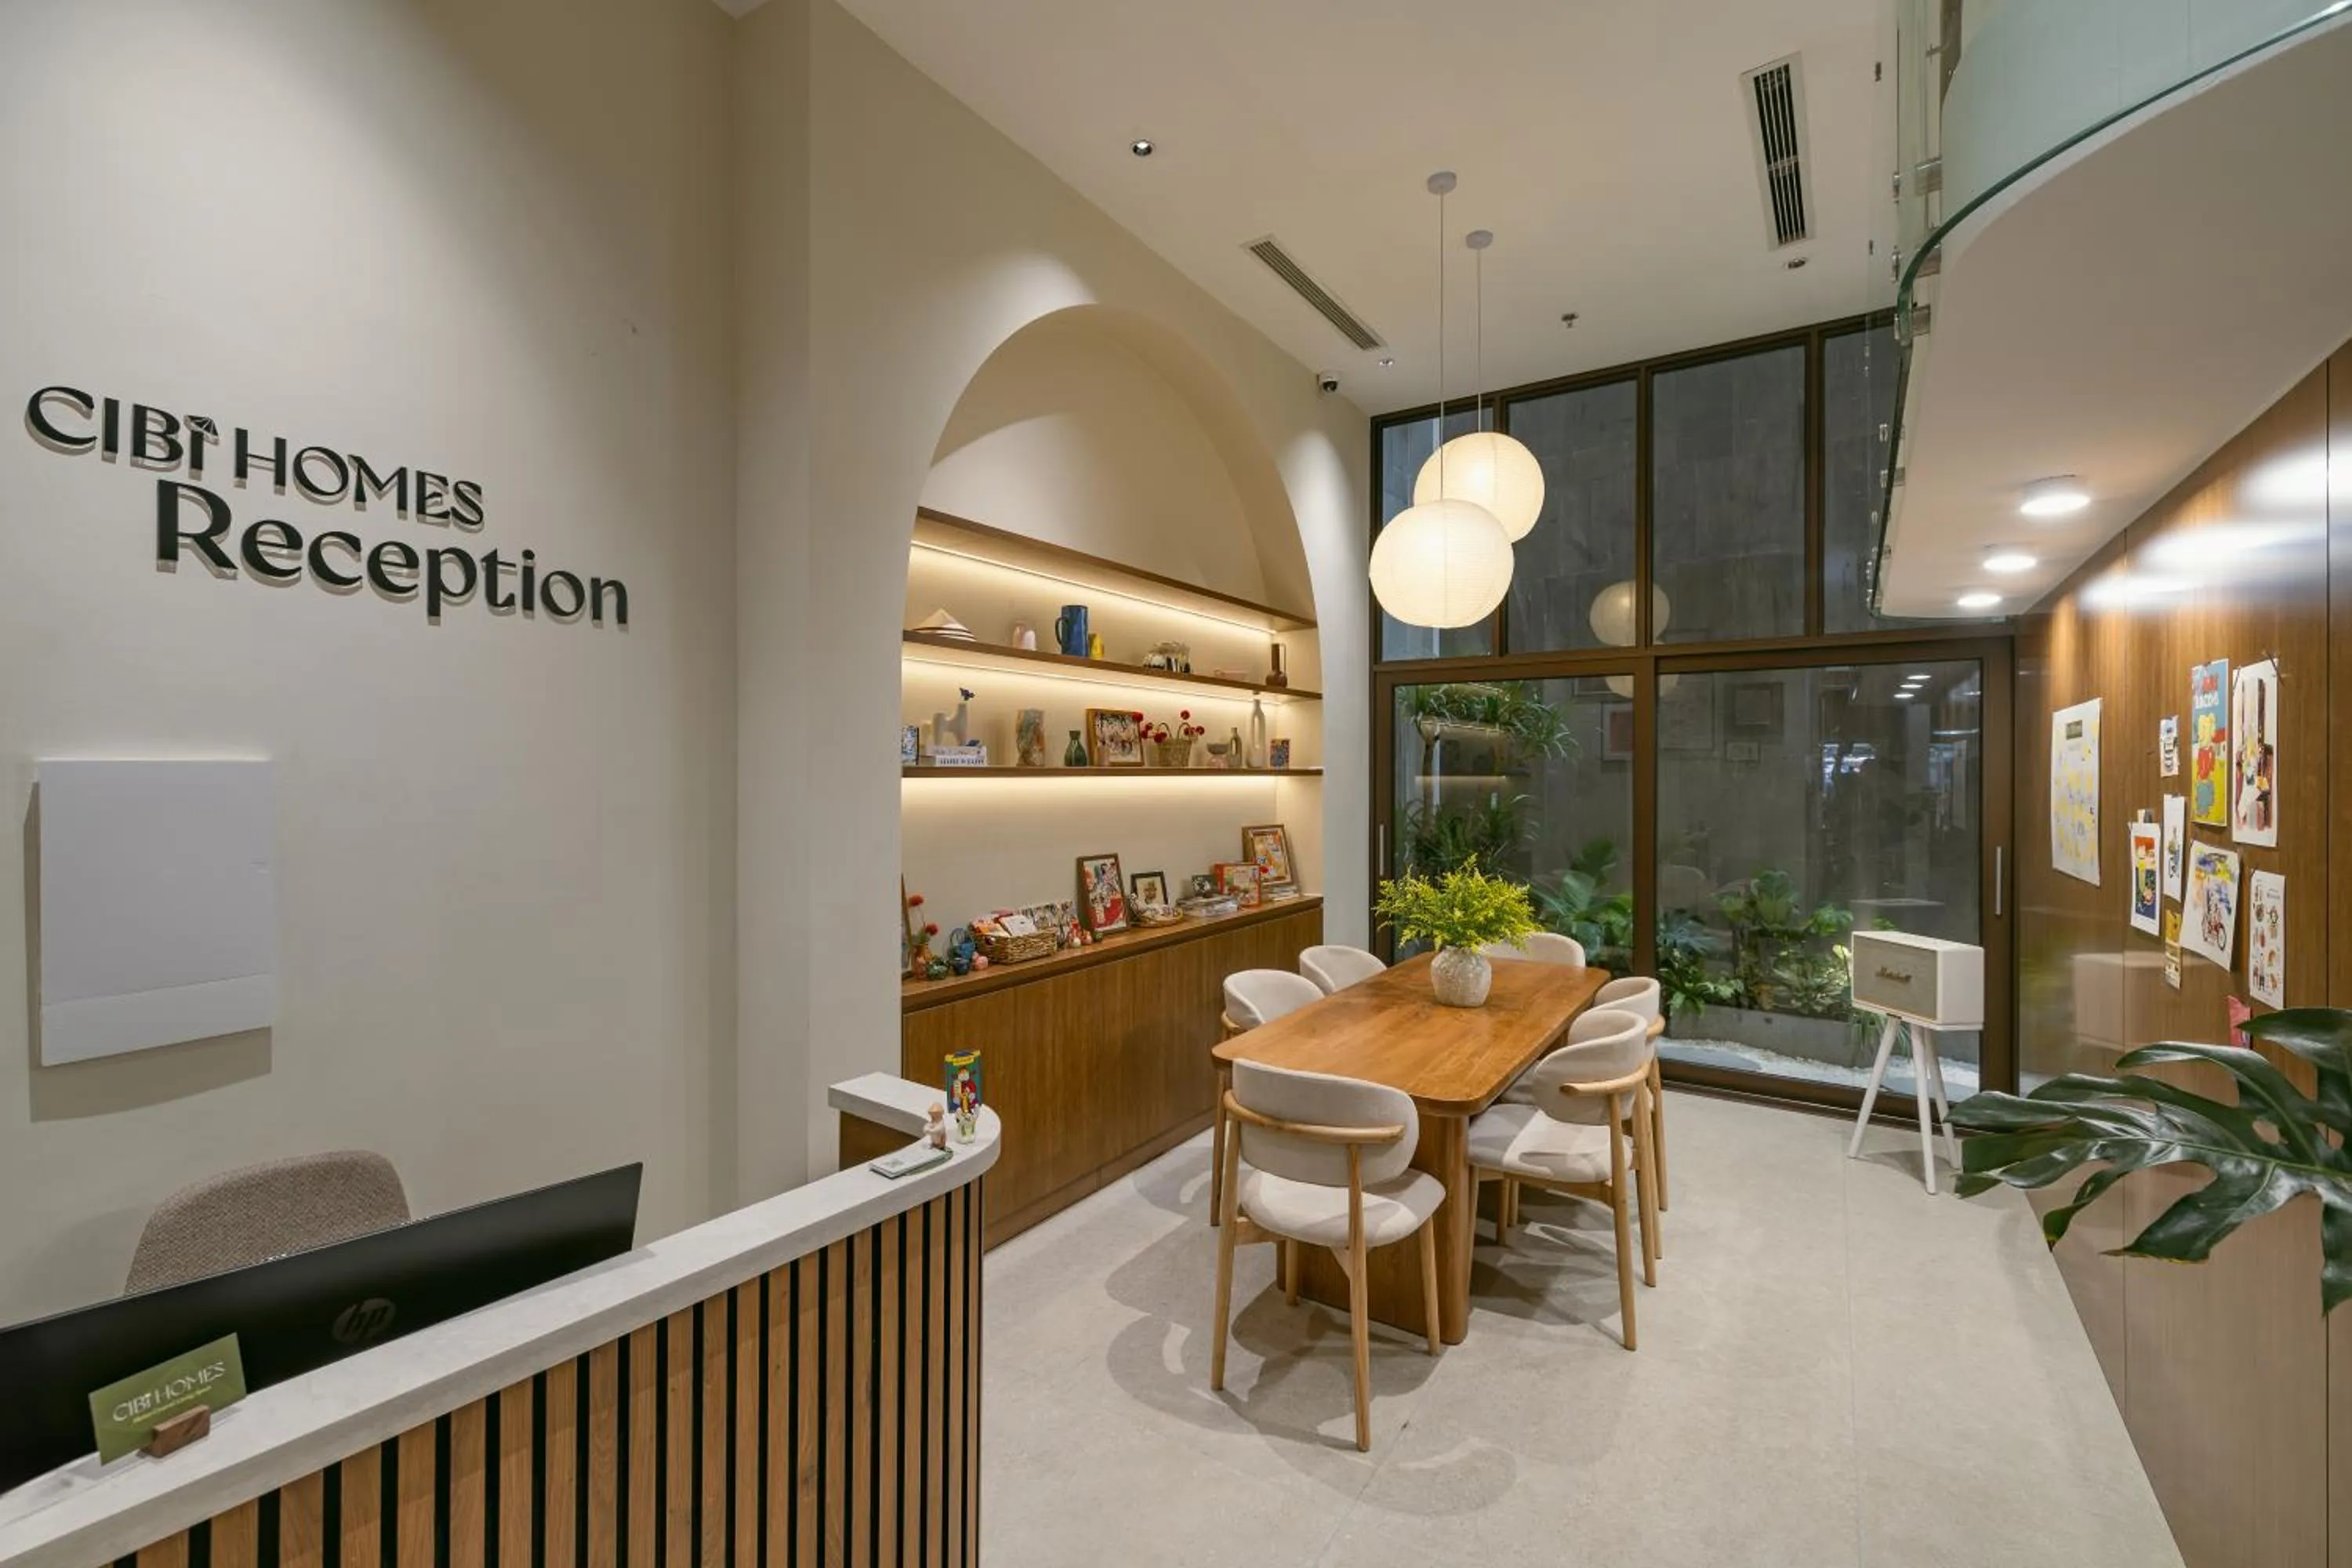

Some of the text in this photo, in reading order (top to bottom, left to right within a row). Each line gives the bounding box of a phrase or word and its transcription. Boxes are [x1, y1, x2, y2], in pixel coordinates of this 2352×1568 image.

[234, 427, 485, 527] HOMES
[157, 478, 629, 626] Reception
[340, 1301, 390, 1343] hp
[154, 1361, 226, 1404] HOMES
